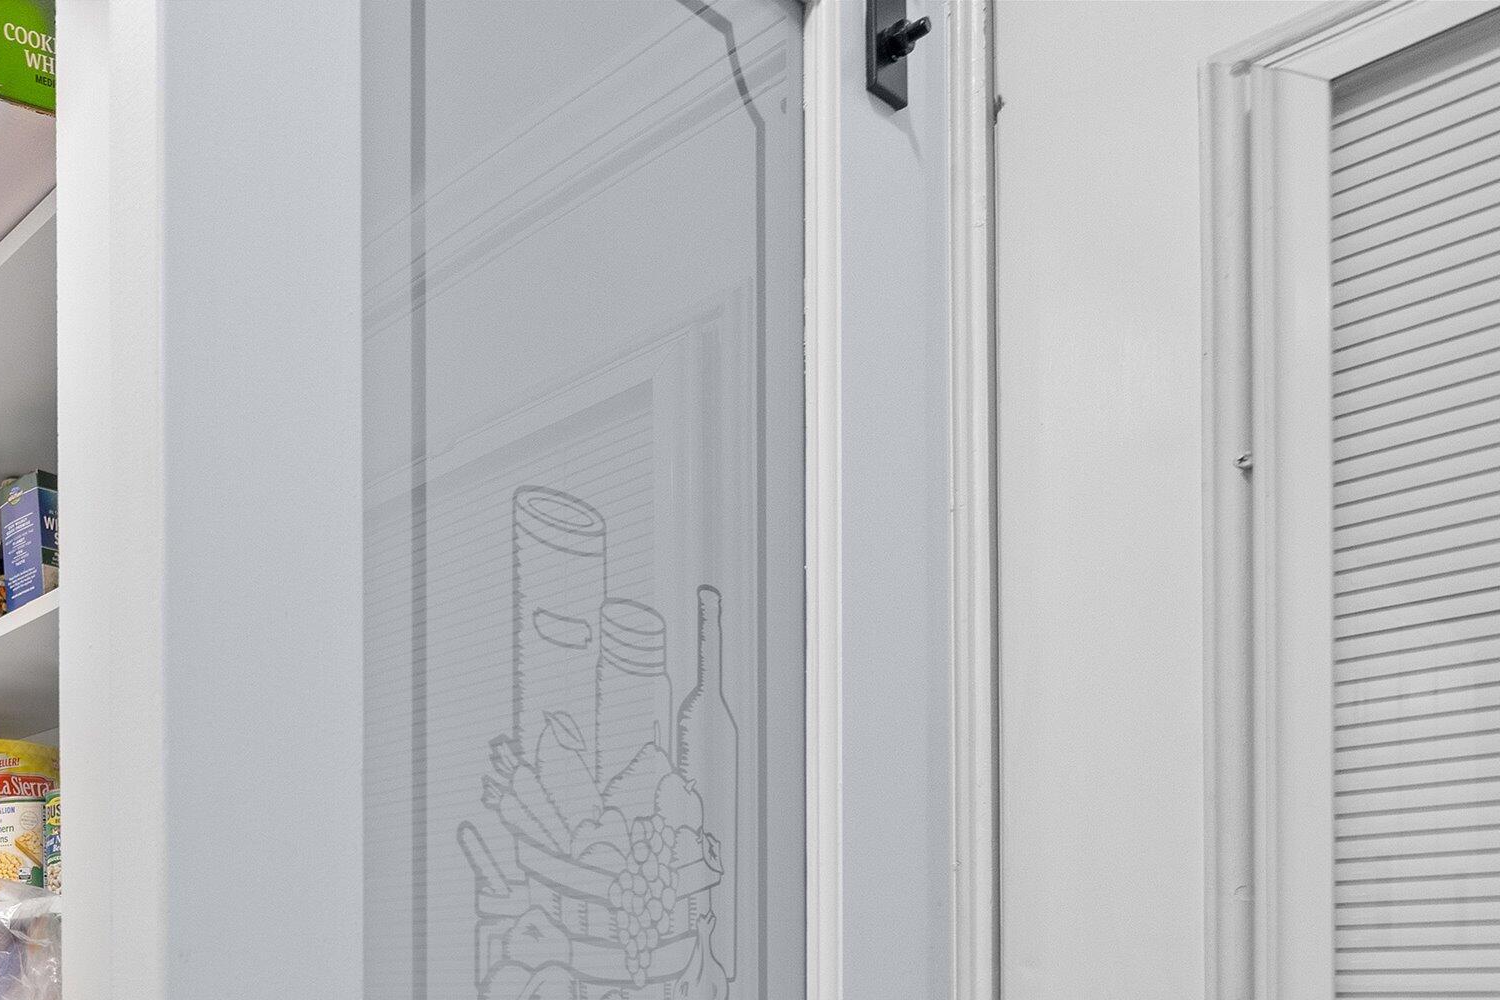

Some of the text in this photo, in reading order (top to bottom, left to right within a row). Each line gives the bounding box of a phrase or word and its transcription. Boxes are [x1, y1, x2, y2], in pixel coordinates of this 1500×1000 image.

[3, 23, 56, 54] COOK
[24, 49, 56, 75] WH
[11, 775, 50, 797] Sierra
[2, 806, 16, 814] LION
